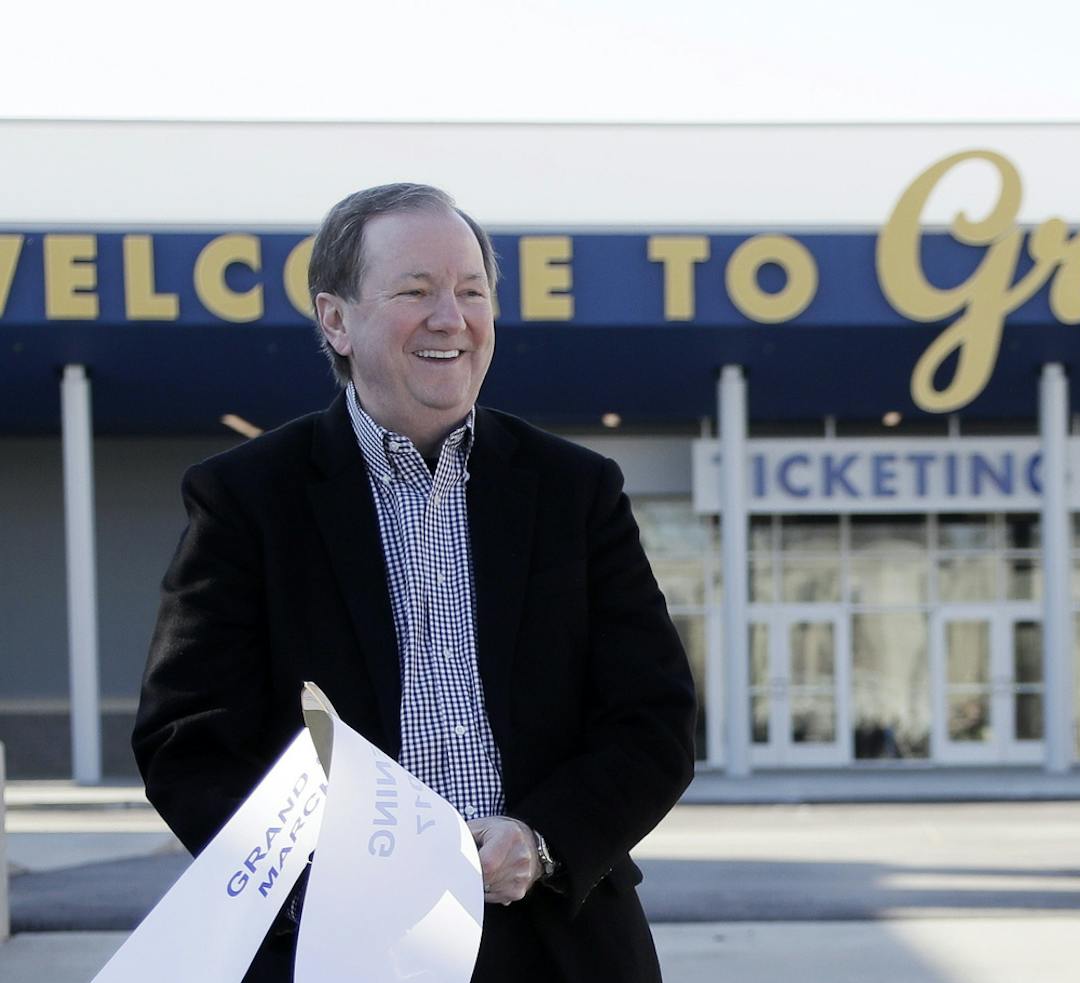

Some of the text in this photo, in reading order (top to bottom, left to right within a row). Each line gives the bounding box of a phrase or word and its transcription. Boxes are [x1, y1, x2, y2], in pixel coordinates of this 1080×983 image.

[0, 233, 575, 323] ELCE
[647, 232, 819, 325] TO
[710, 451, 1071, 497] ICKETIN
[227, 772, 309, 898] GRAND
